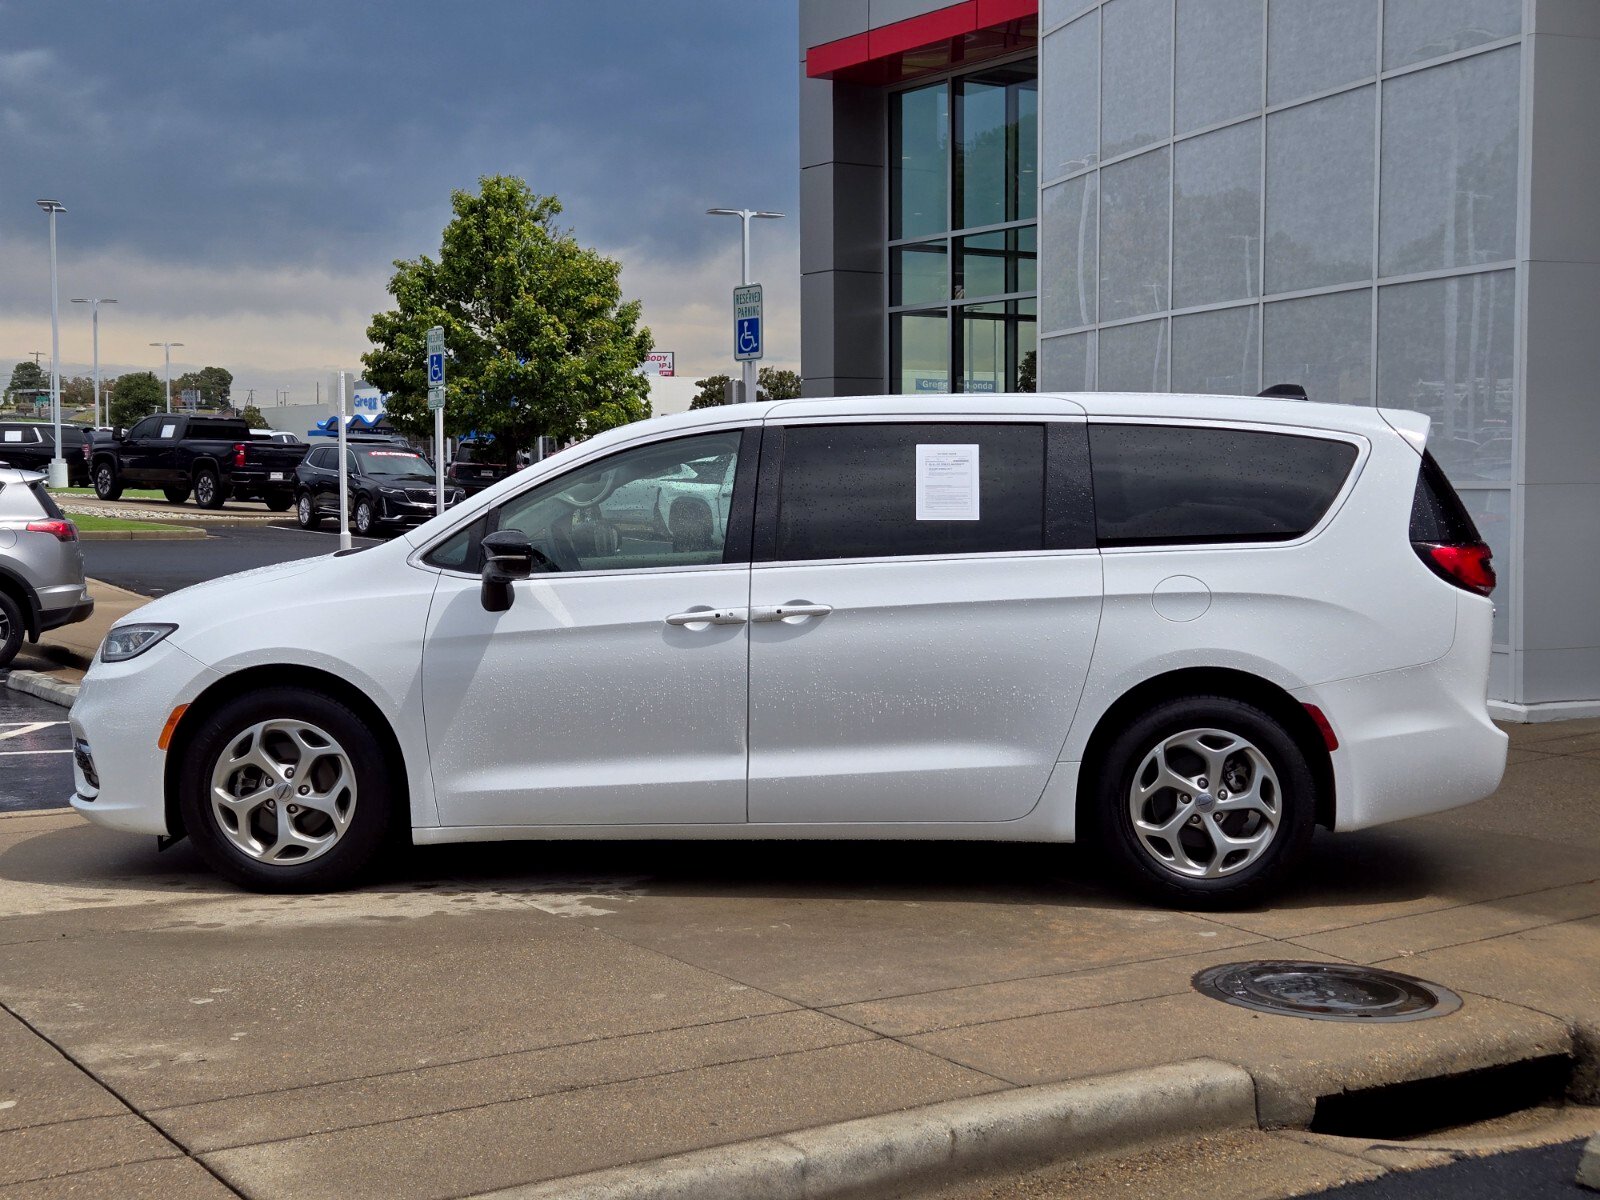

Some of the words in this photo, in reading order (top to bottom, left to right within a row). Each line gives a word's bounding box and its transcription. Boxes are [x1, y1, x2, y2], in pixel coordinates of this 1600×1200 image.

[736, 292, 760, 304] RESERVED
[737, 305, 759, 318] PARKING
[354, 394, 378, 410] Gregg
